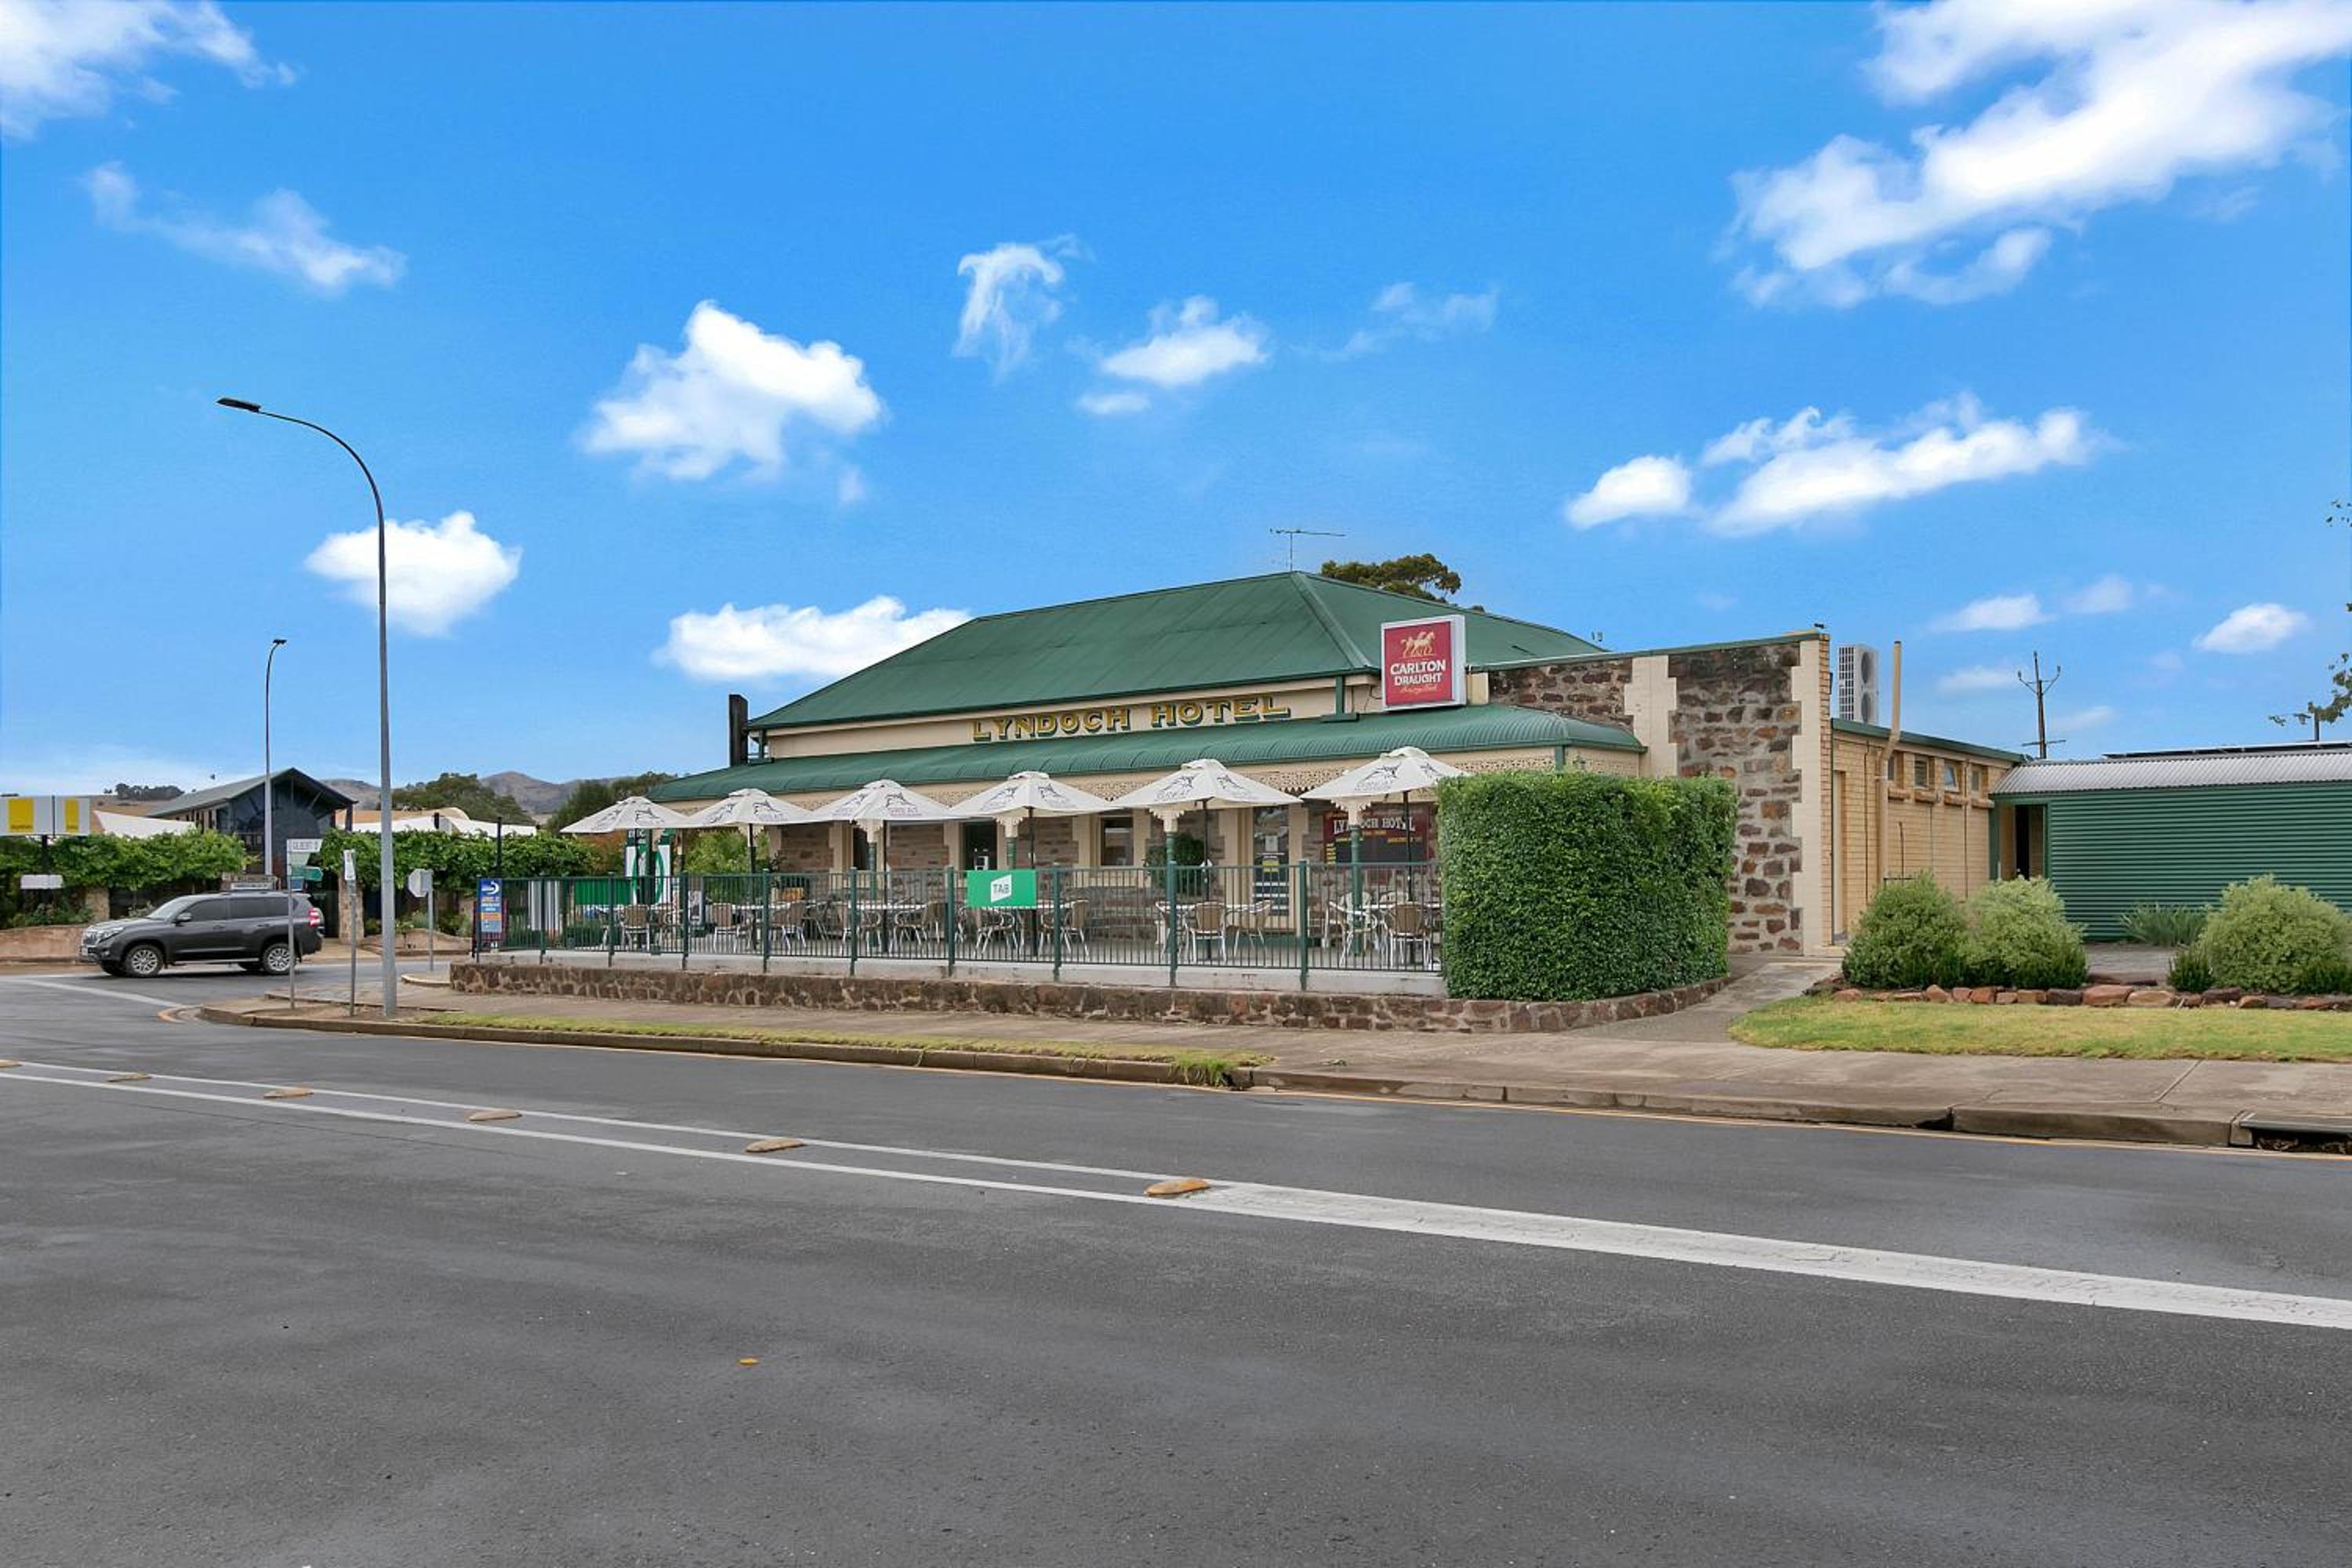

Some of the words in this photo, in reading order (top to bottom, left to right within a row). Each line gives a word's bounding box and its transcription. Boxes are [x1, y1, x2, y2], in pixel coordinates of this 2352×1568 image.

[1390, 659, 1446, 675] CARLTON
[1395, 673, 1443, 686] DRAUGHT
[973, 705, 1131, 742] LYNDOCH
[1151, 695, 1291, 728] HOTEL
[993, 884, 1010, 894] TAB
